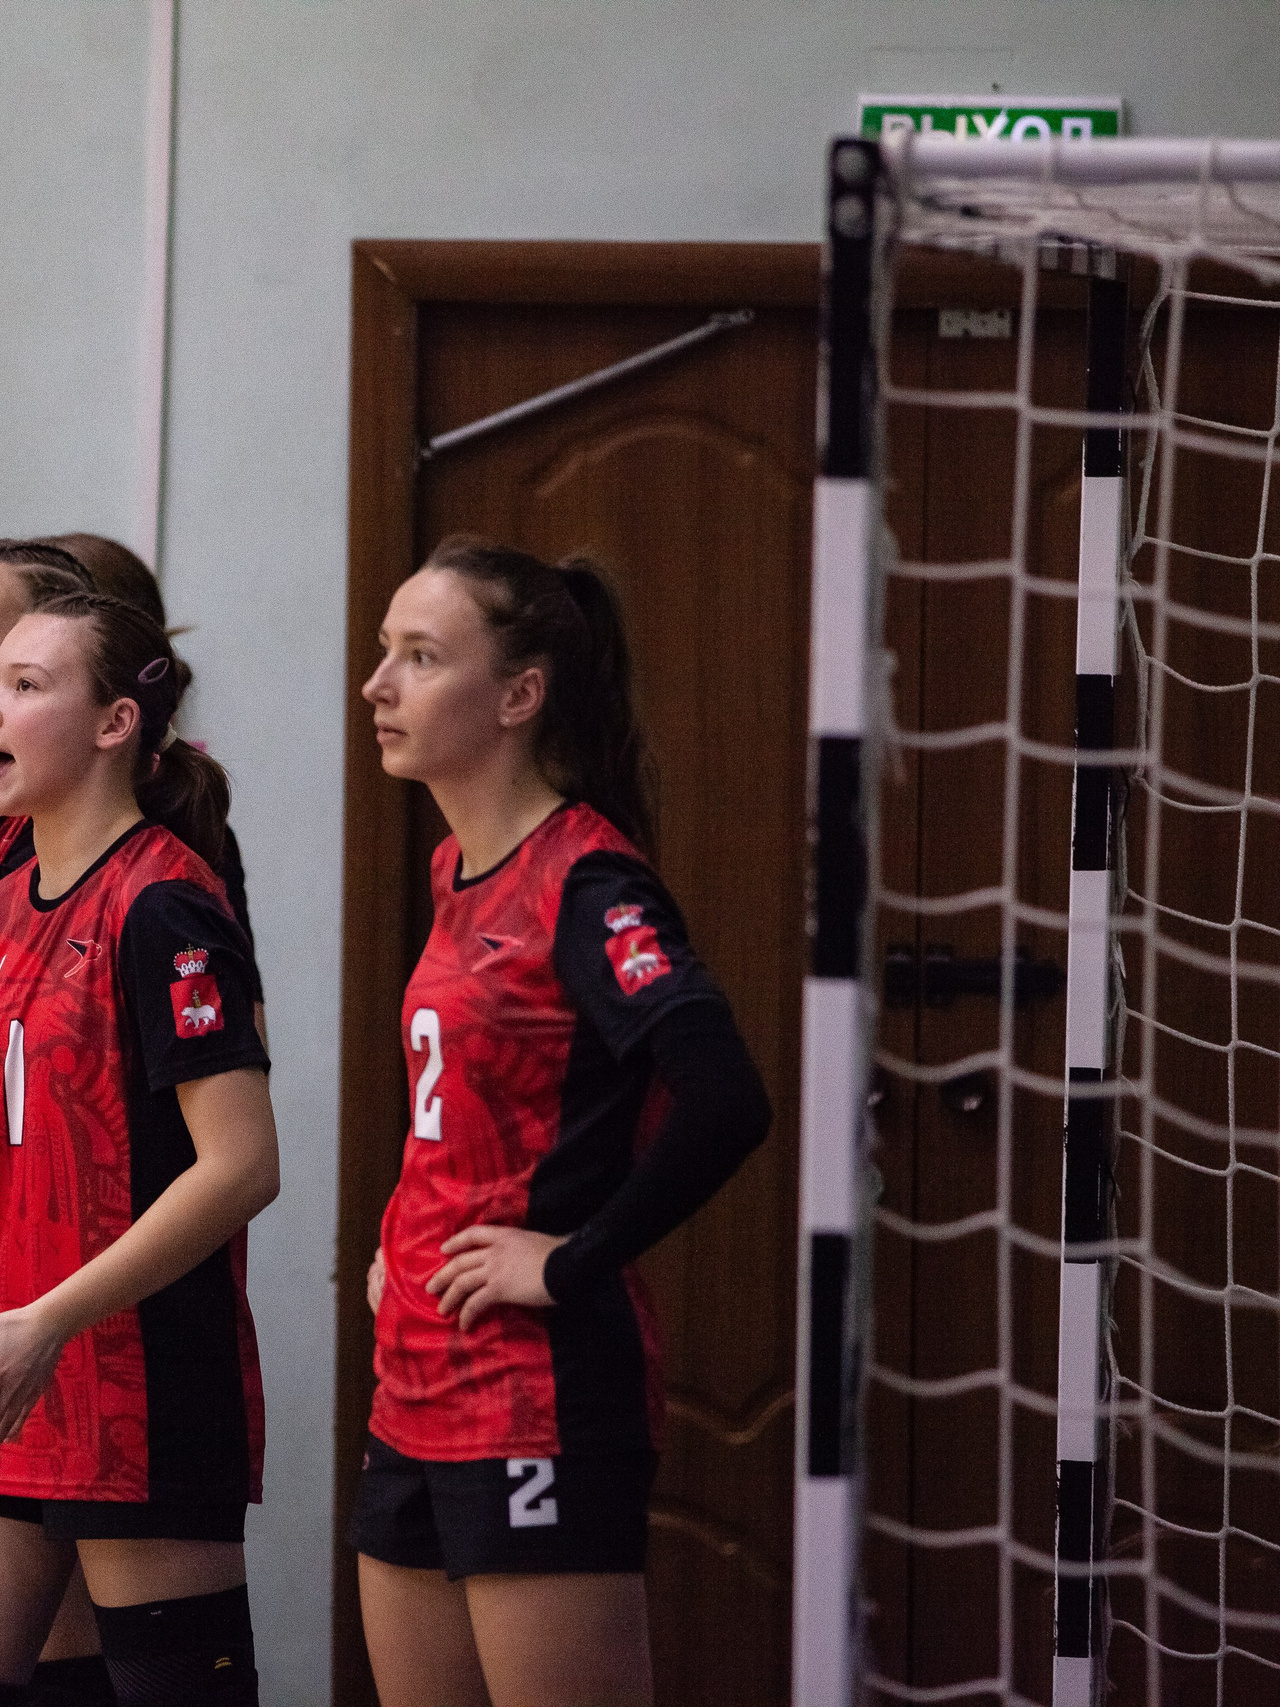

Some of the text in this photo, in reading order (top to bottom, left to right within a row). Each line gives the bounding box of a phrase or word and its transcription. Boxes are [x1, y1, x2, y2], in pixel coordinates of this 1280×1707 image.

[4, 1018, 25, 1145] 1
[410, 1007, 444, 1141] 2
[506, 1457, 559, 1528] 2
